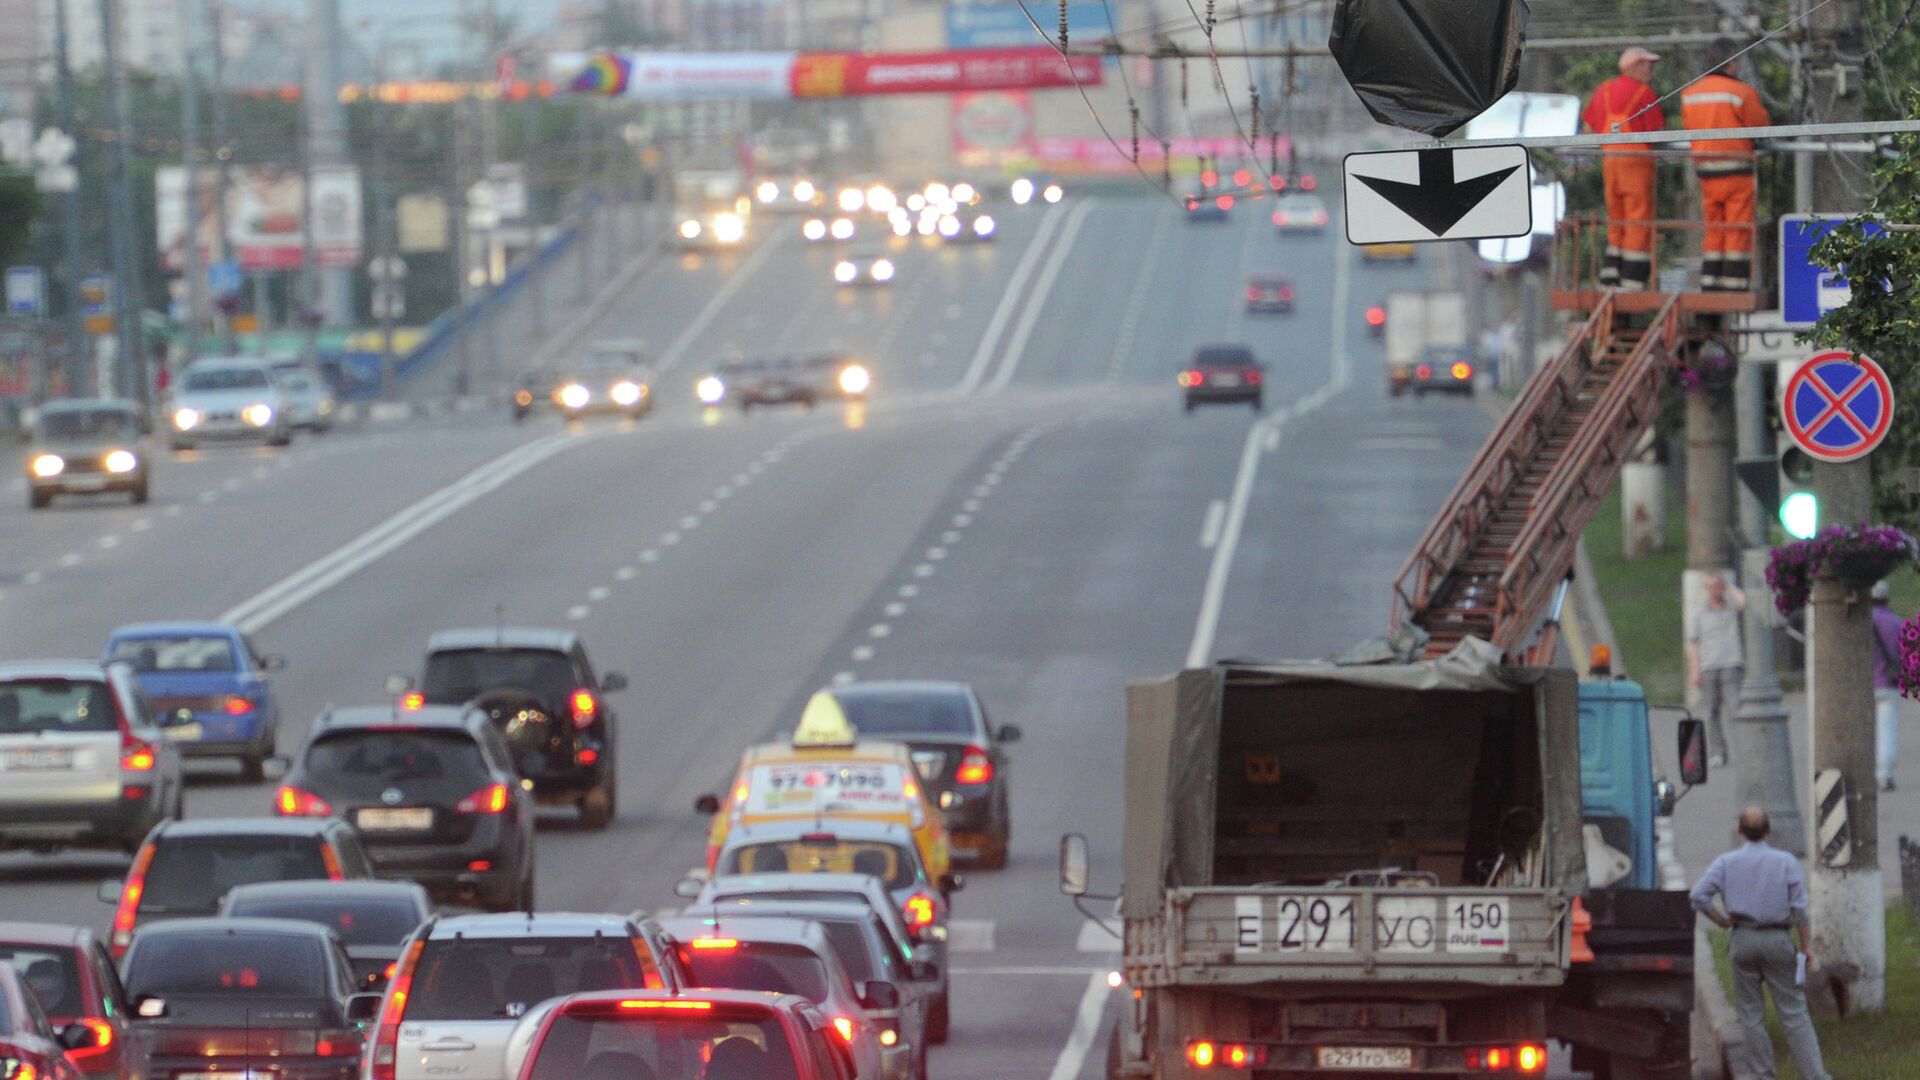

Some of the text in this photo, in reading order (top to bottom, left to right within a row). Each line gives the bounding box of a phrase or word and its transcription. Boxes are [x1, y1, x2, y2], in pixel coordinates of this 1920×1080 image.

[1238, 916, 1258, 948] Е
[1281, 899, 1355, 949] 291
[1454, 903, 1502, 930] 150
